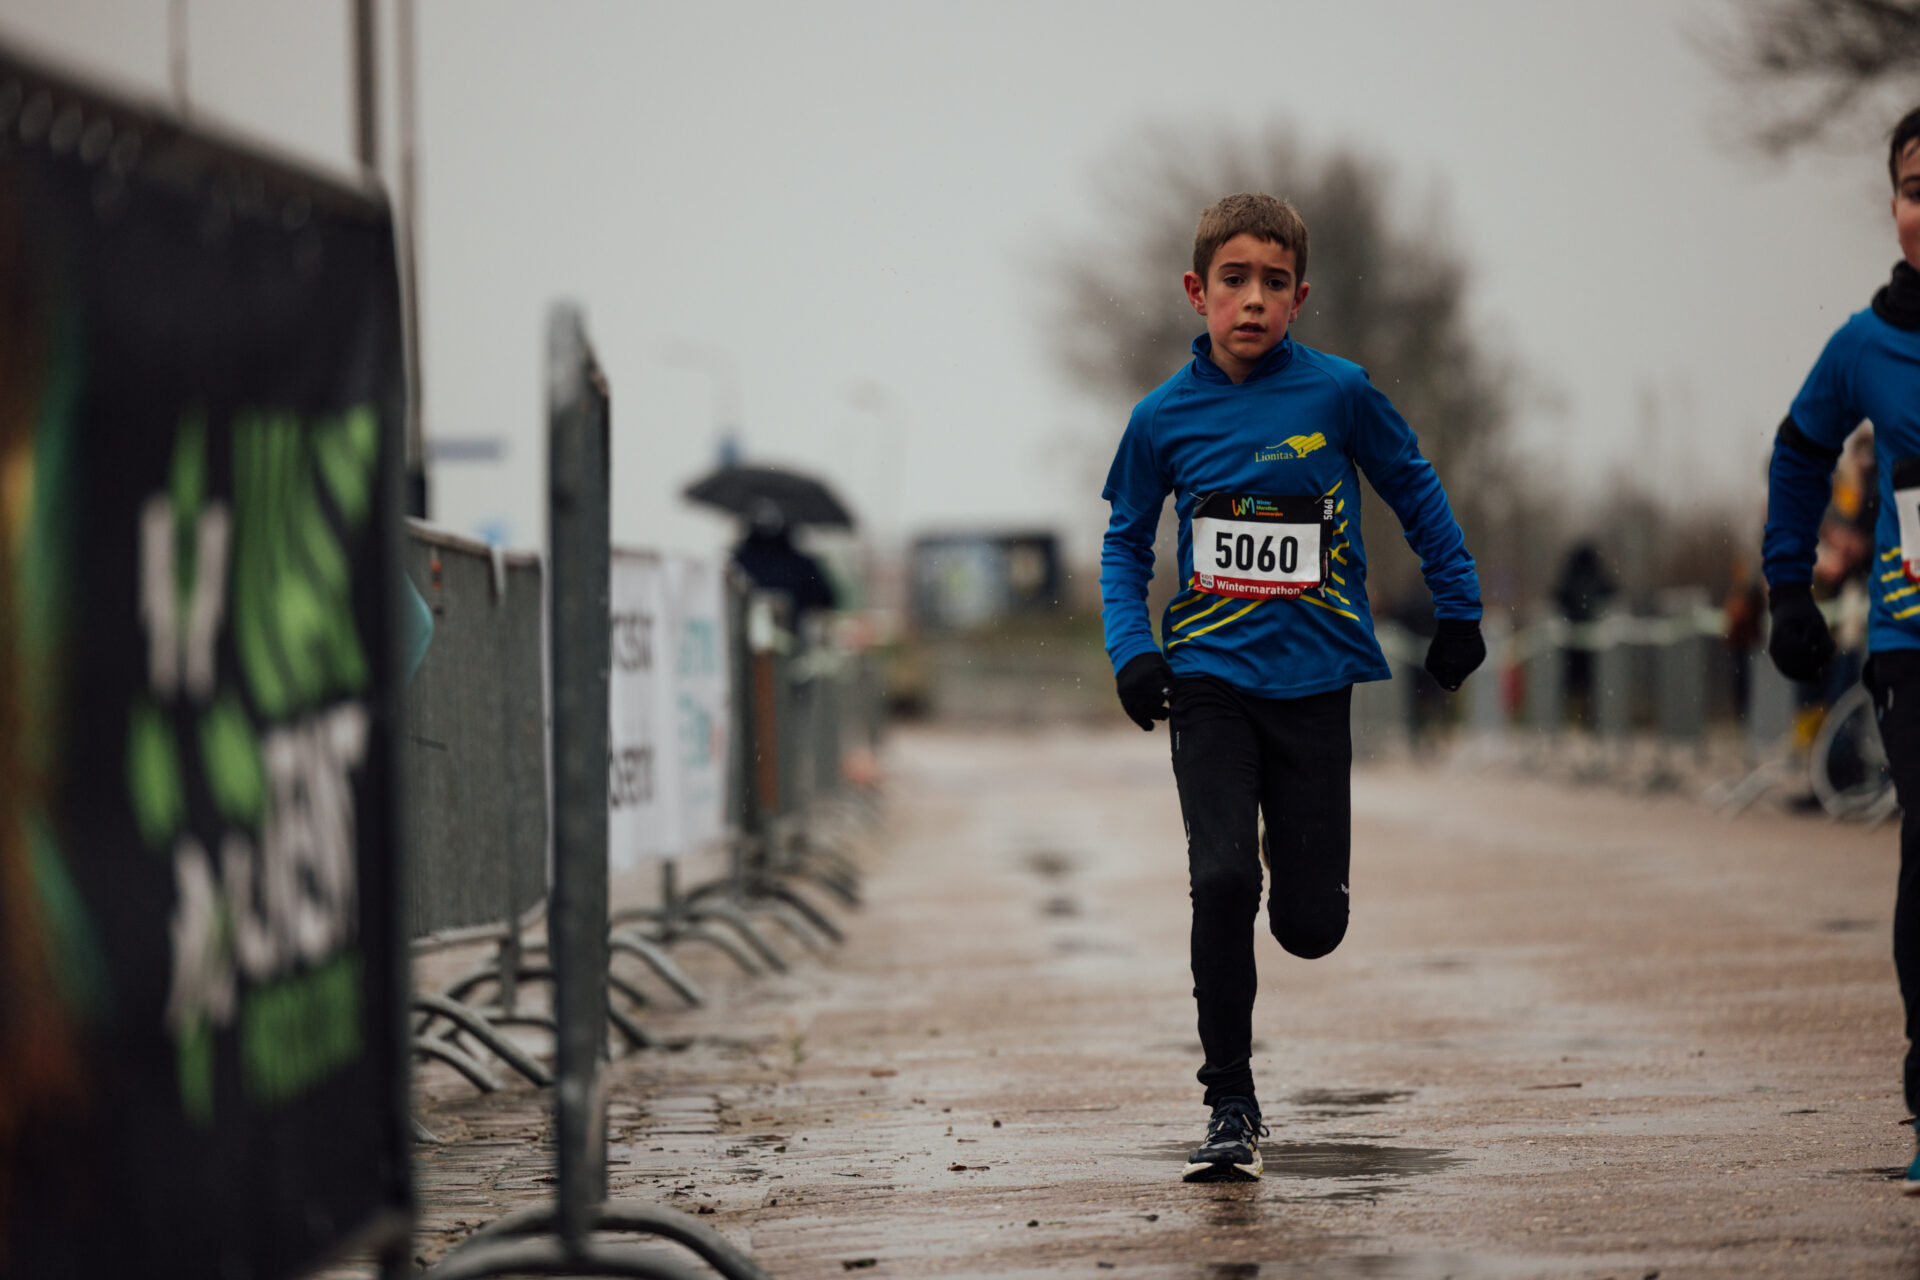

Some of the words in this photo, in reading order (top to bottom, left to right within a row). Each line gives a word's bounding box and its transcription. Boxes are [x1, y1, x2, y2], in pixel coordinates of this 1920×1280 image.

[1255, 450, 1294, 463] Lionitas
[1323, 498, 1334, 520] 5060
[1216, 531, 1298, 574] 5060
